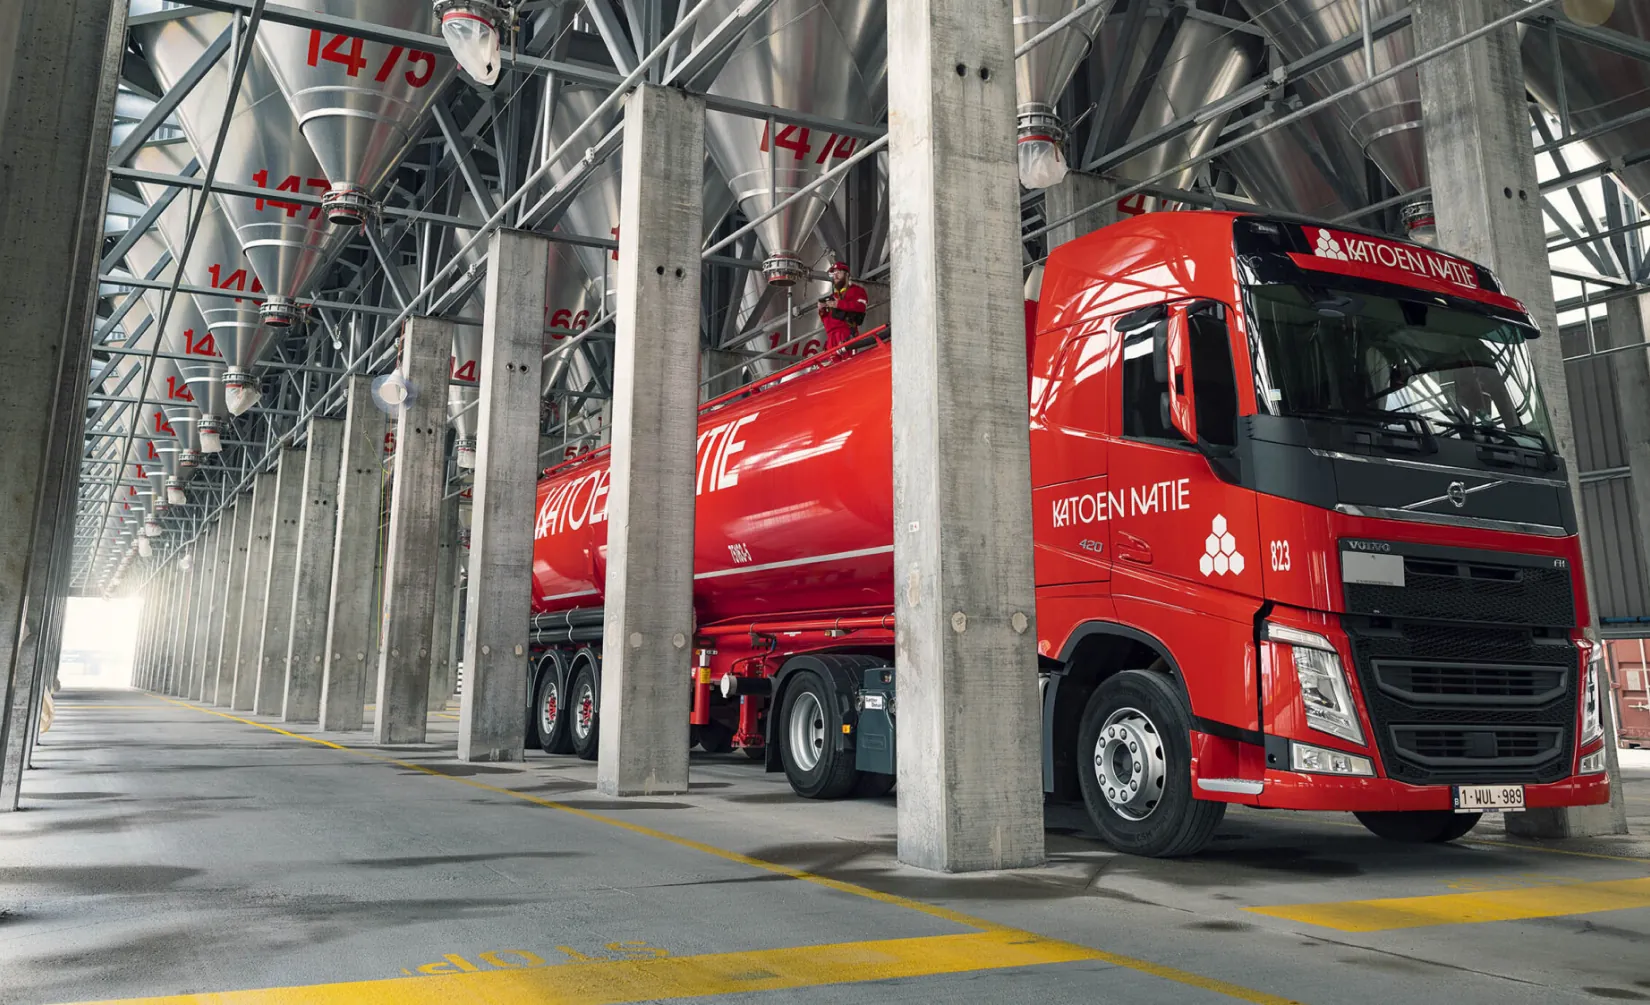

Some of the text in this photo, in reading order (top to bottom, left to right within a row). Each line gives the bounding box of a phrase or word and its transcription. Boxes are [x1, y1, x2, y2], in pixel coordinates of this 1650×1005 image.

[307, 28, 436, 88] 1475
[252, 169, 332, 220] 147
[1344, 237, 1477, 287] KATOEN NATIE
[534, 412, 760, 540] KATOE TIE
[1052, 478, 1190, 528] KATOEN NATIE
[1079, 539, 1103, 553] 420
[1270, 540, 1291, 571] 823
[1347, 540, 1391, 553] VOLVO
